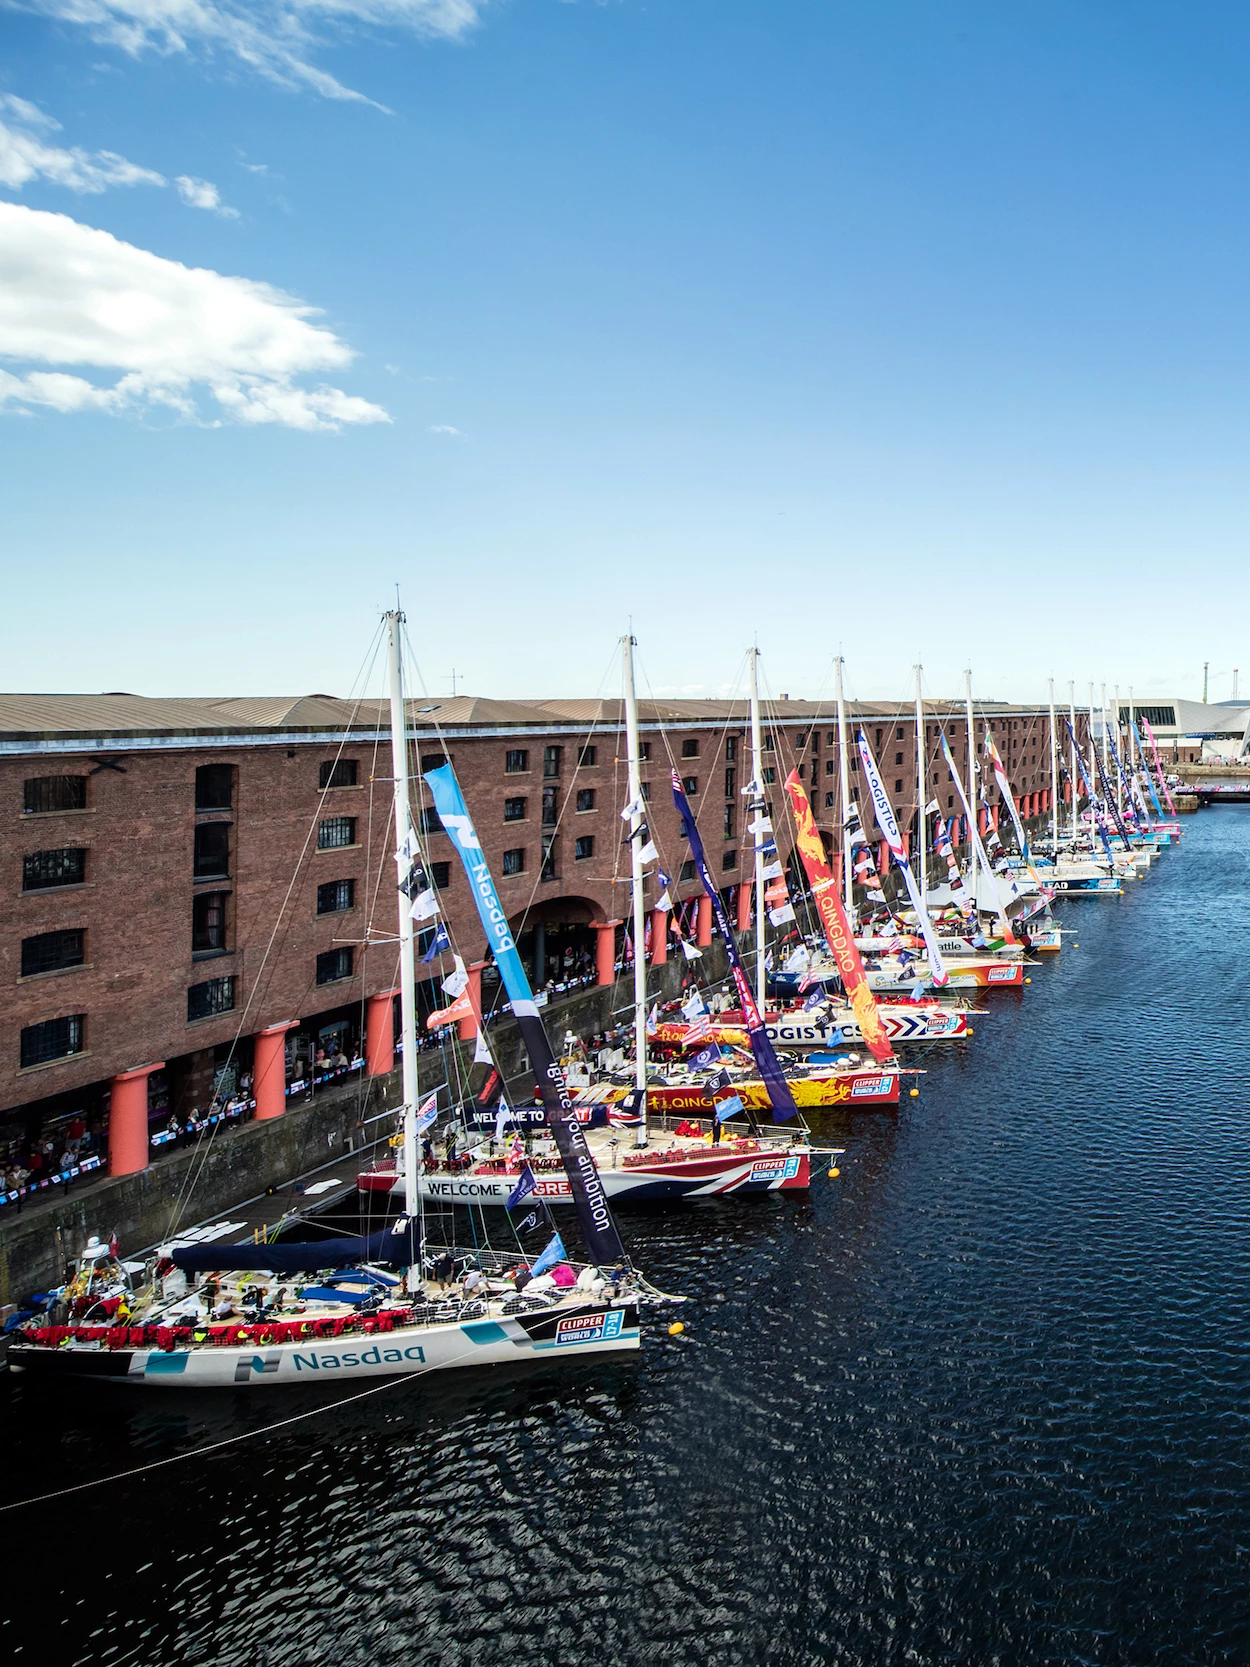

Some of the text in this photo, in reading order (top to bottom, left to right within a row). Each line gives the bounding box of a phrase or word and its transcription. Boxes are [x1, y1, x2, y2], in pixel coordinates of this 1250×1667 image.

[870, 772, 897, 836] LOGISTICS
[472, 862, 514, 954] Nasdaq
[821, 896, 855, 973] QINGDAO
[937, 941, 962, 951] attle
[765, 1024, 864, 1040] OGISTICS
[473, 1110, 527, 1123] WELME
[528, 1110, 544, 1122] TO
[561, 1106, 587, 1149] your
[578, 1155, 610, 1232] ambition
[754, 1161, 785, 1171] CLIPPER
[428, 1182, 502, 1196] WELCOME
[534, 1181, 572, 1195] GRE
[562, 1316, 603, 1330] CLIPPER
[293, 1346, 427, 1371] Nasdaq
